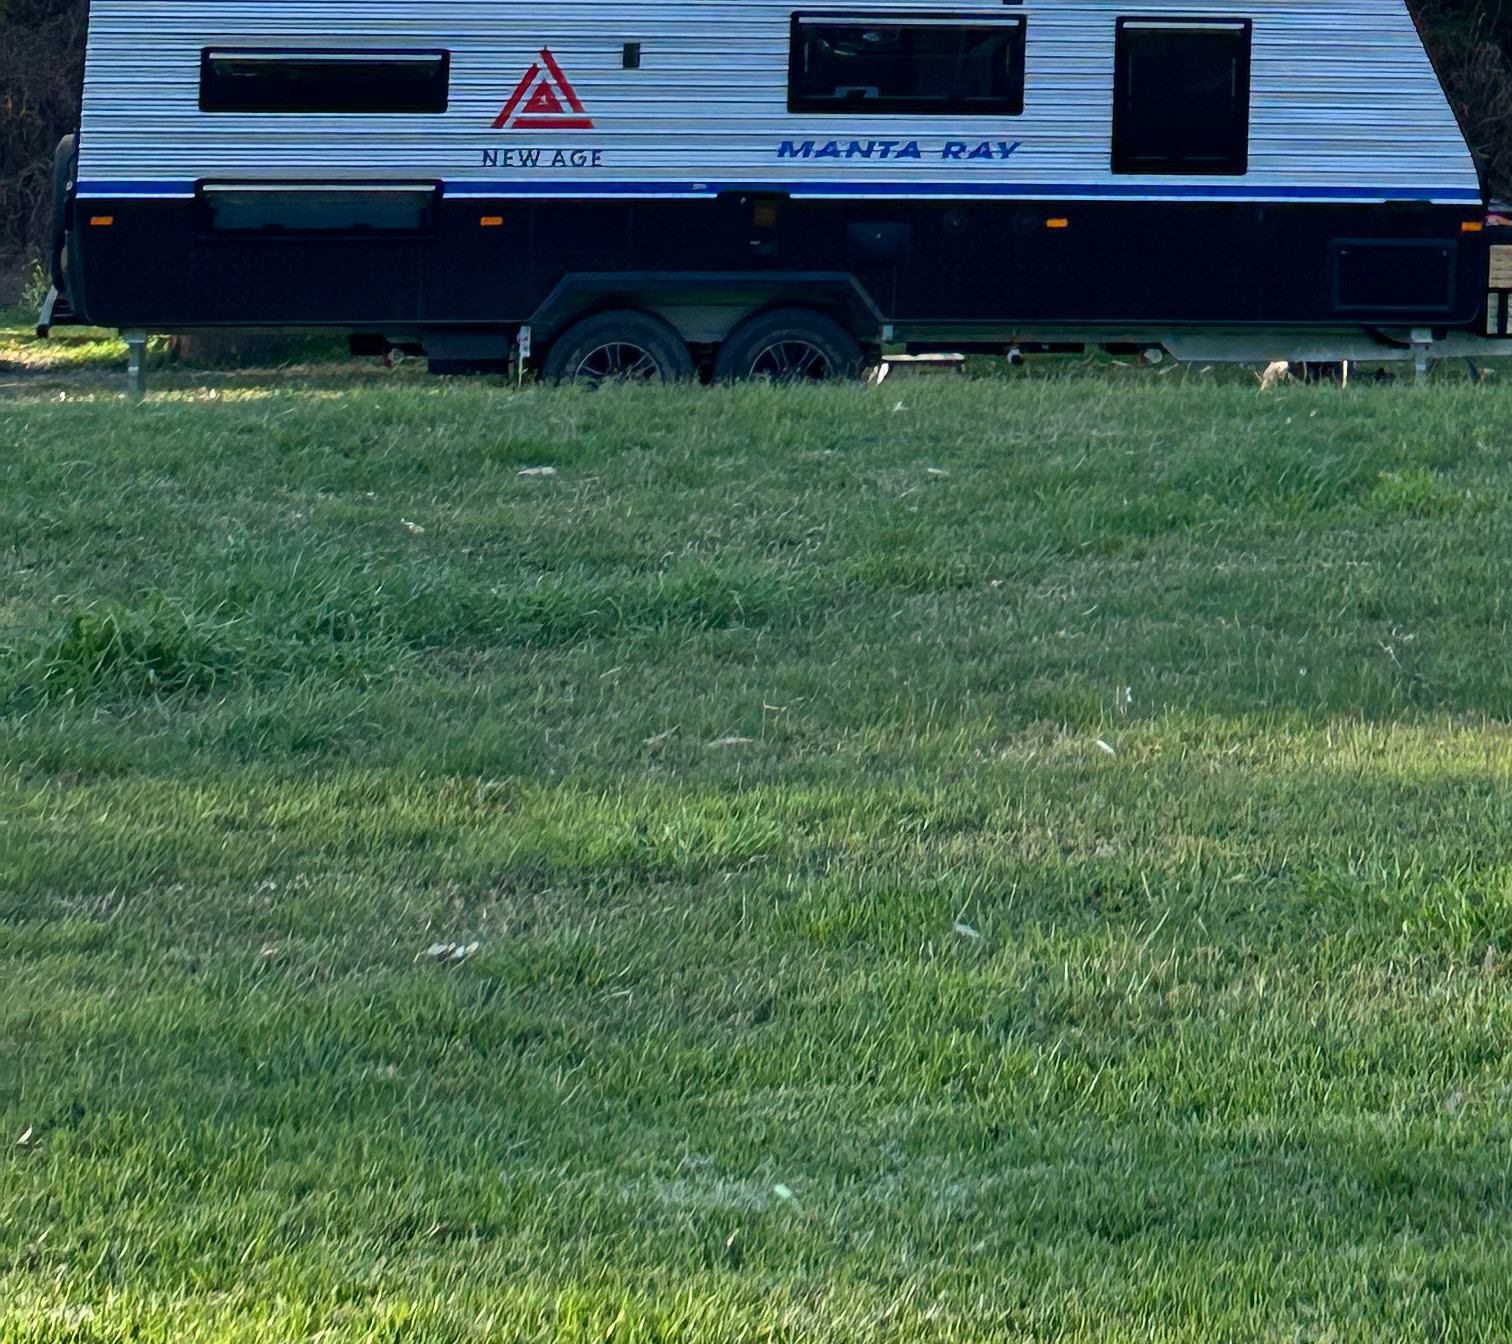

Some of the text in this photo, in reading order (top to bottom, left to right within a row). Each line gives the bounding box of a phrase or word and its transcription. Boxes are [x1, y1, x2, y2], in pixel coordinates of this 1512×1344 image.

[483, 148, 604, 168] NEW AGE
[777, 140, 1022, 159] MANTA RAY
